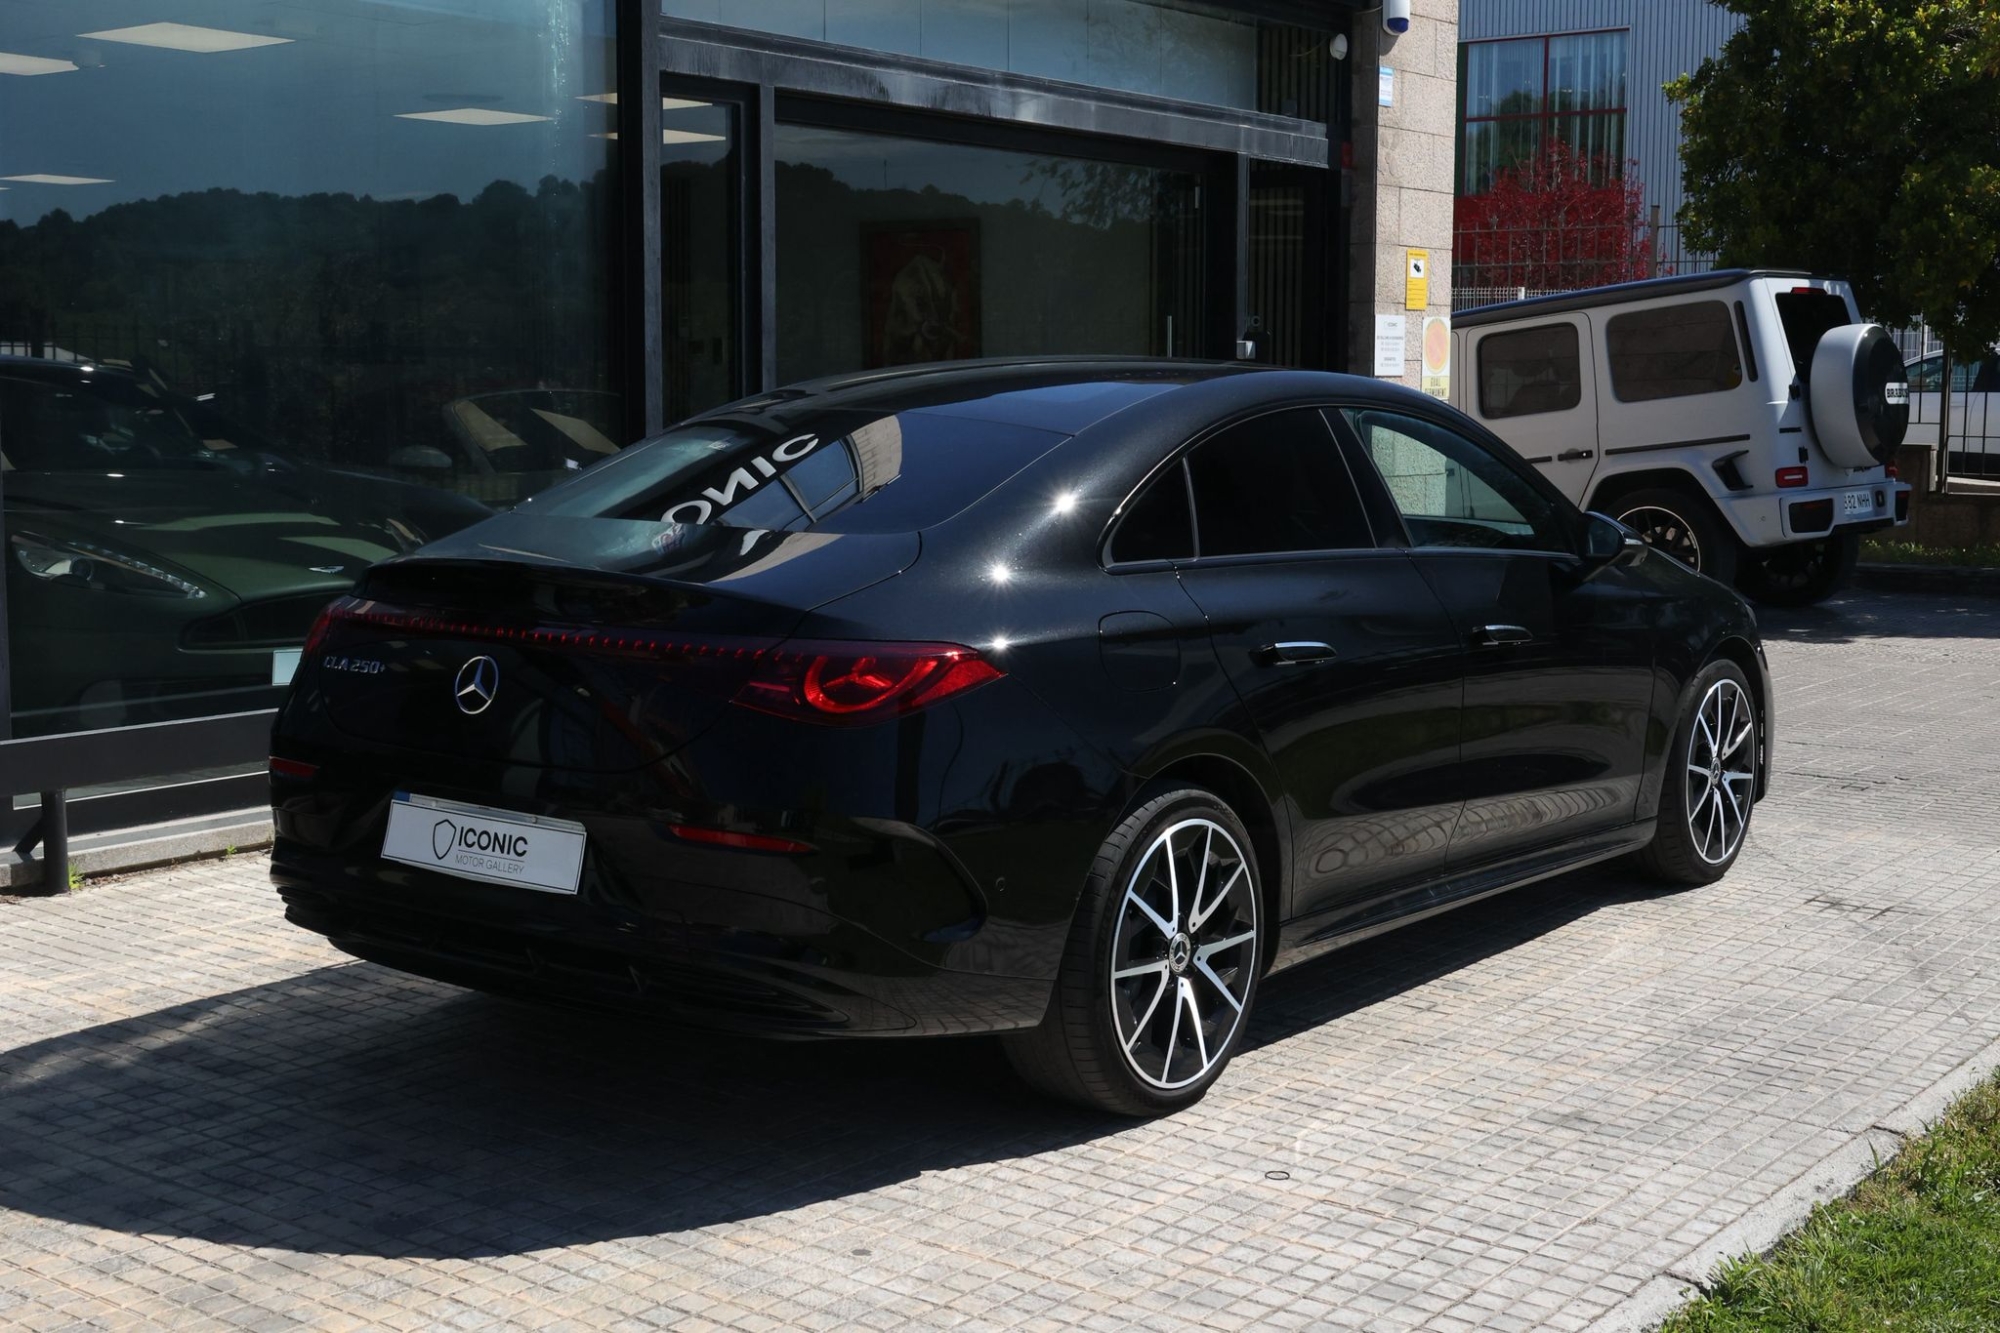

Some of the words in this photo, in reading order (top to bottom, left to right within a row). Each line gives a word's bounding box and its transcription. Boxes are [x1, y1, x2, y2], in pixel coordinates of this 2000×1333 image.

[324, 656, 349, 671] CLA
[458, 826, 528, 857] ICONIC
[455, 854, 485, 869] MOTOR
[486, 859, 525, 875] GALLERY
